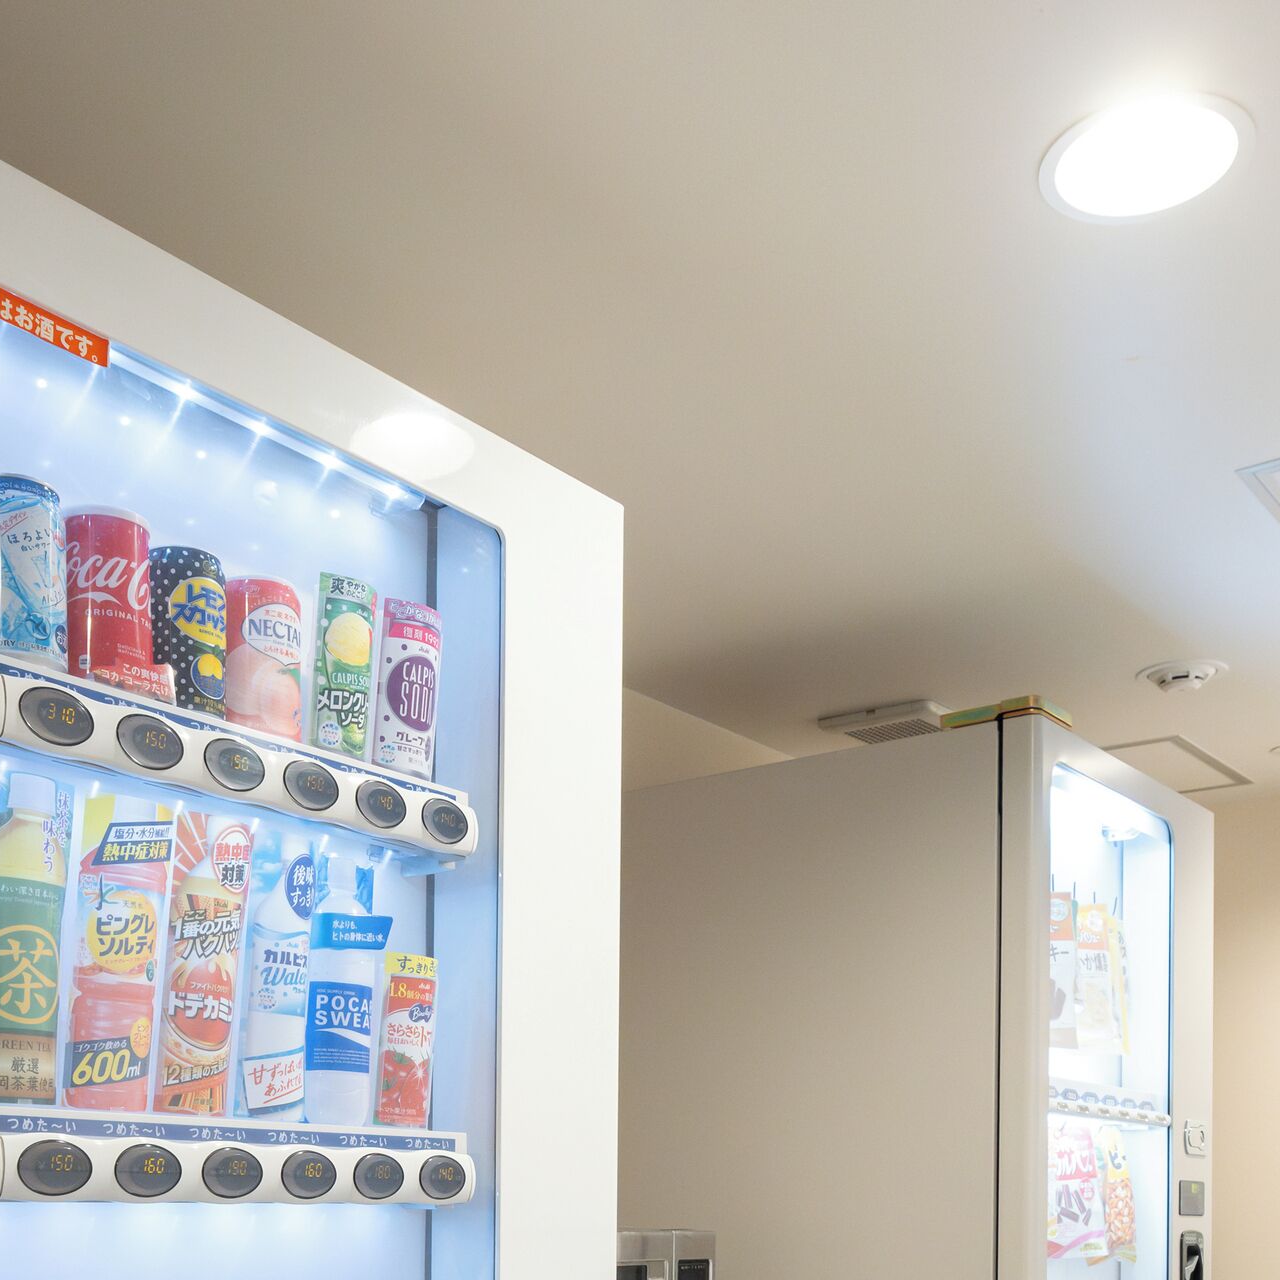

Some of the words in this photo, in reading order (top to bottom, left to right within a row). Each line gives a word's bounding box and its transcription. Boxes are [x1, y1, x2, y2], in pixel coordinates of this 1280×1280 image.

[403, 661, 435, 689] CALPIS
[42, 819, 57, 874] 味わう
[101, 842, 170, 862] 熱中症対策
[96, 914, 156, 936] ピングレ
[98, 936, 155, 957] ソルティ
[10, 1056, 41, 1076] 厳選
